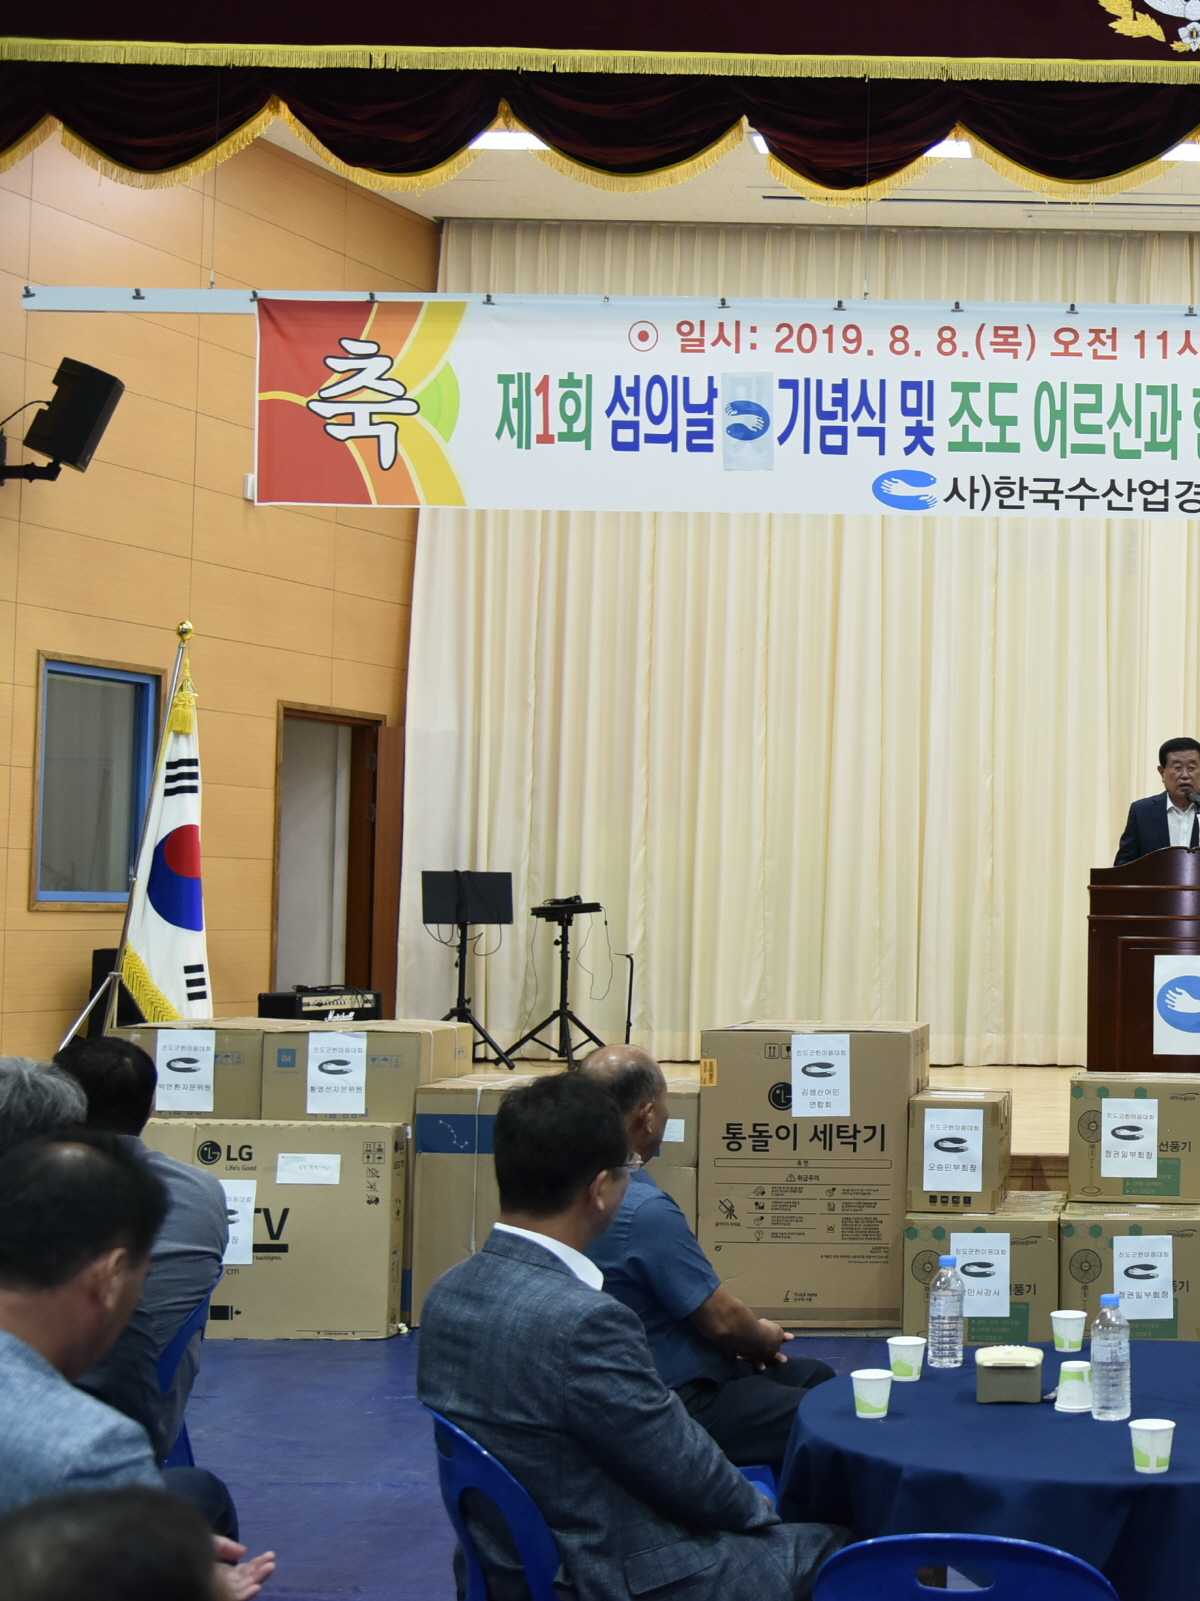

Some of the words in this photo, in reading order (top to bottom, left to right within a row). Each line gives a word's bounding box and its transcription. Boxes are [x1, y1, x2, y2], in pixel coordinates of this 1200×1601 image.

[676, 320, 758, 355] 일시:
[774, 323, 874, 356] 2019.
[888, 325, 922, 357] 8.
[936, 323, 1037, 361] 8.(목)
[1050, 326, 1119, 361] 오전
[305, 336, 420, 471] 축
[495, 371, 594, 451] 제1회
[604, 373, 719, 454] 섬의날
[776, 376, 887, 457] 기념식
[900, 378, 936, 457] 및
[947, 380, 1021, 455] 조도
[1033, 380, 1182, 462] 어르신과
[796, 1049, 847, 1057] 진도군한마음대회
[929, 1124, 980, 1132] 진도군한마음대회
[721, 1122, 799, 1153] 통돌이
[809, 1122, 887, 1153] 세탁기
[226, 1144, 254, 1162] LG
[1158, 1141, 1192, 1153] 선풍기
[928, 1163, 977, 1173] 오승민부회장
[955, 1248, 1007, 1256] 진도군한마음대회
[962, 1288, 1001, 1297] 민서감사
